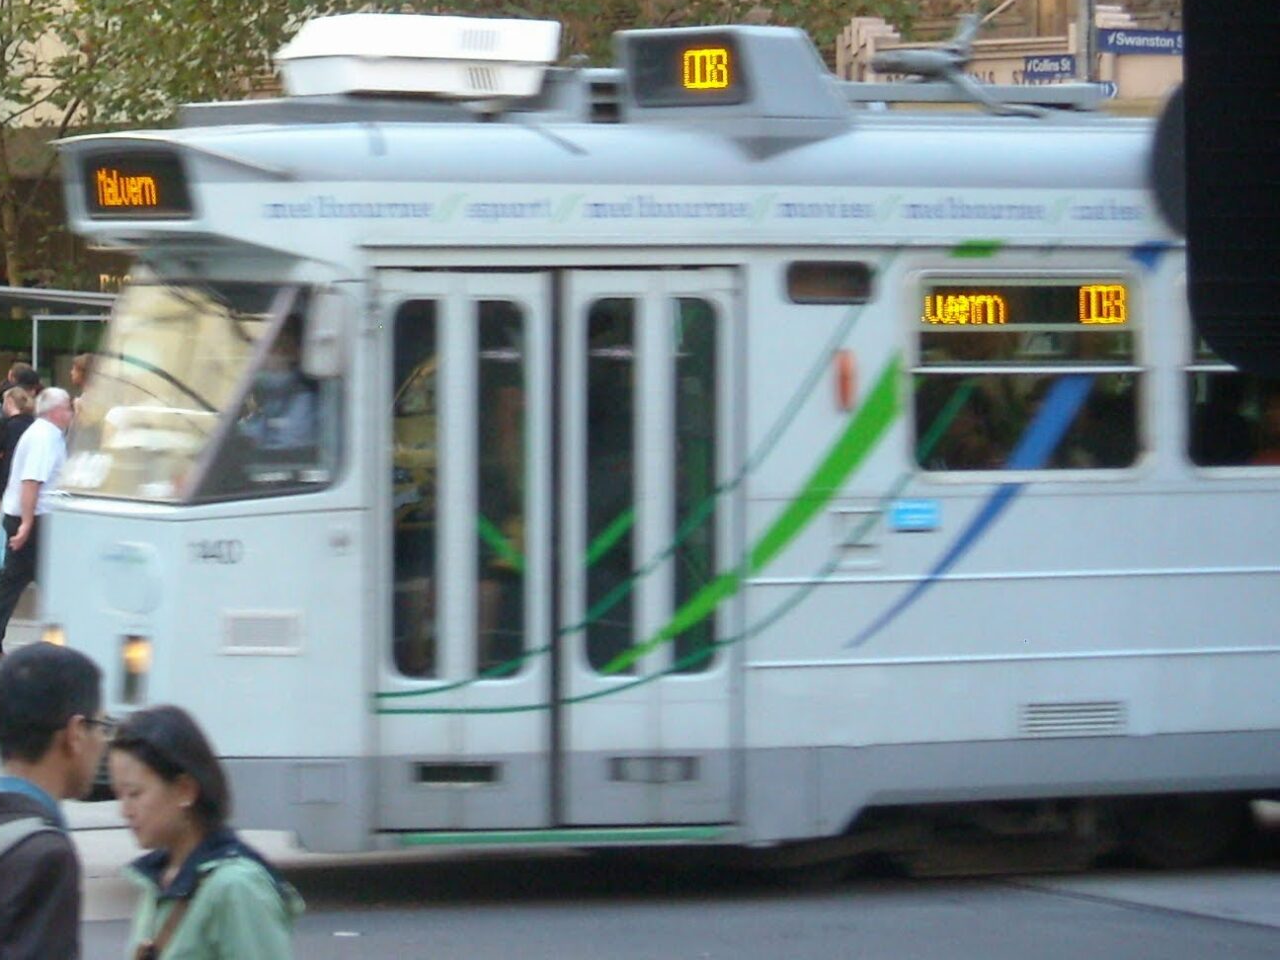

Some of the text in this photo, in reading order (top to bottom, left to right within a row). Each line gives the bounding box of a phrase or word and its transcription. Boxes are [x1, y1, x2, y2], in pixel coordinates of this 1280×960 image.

[1115, 31, 1184, 49] Swanston S
[1032, 57, 1071, 73] Collins St
